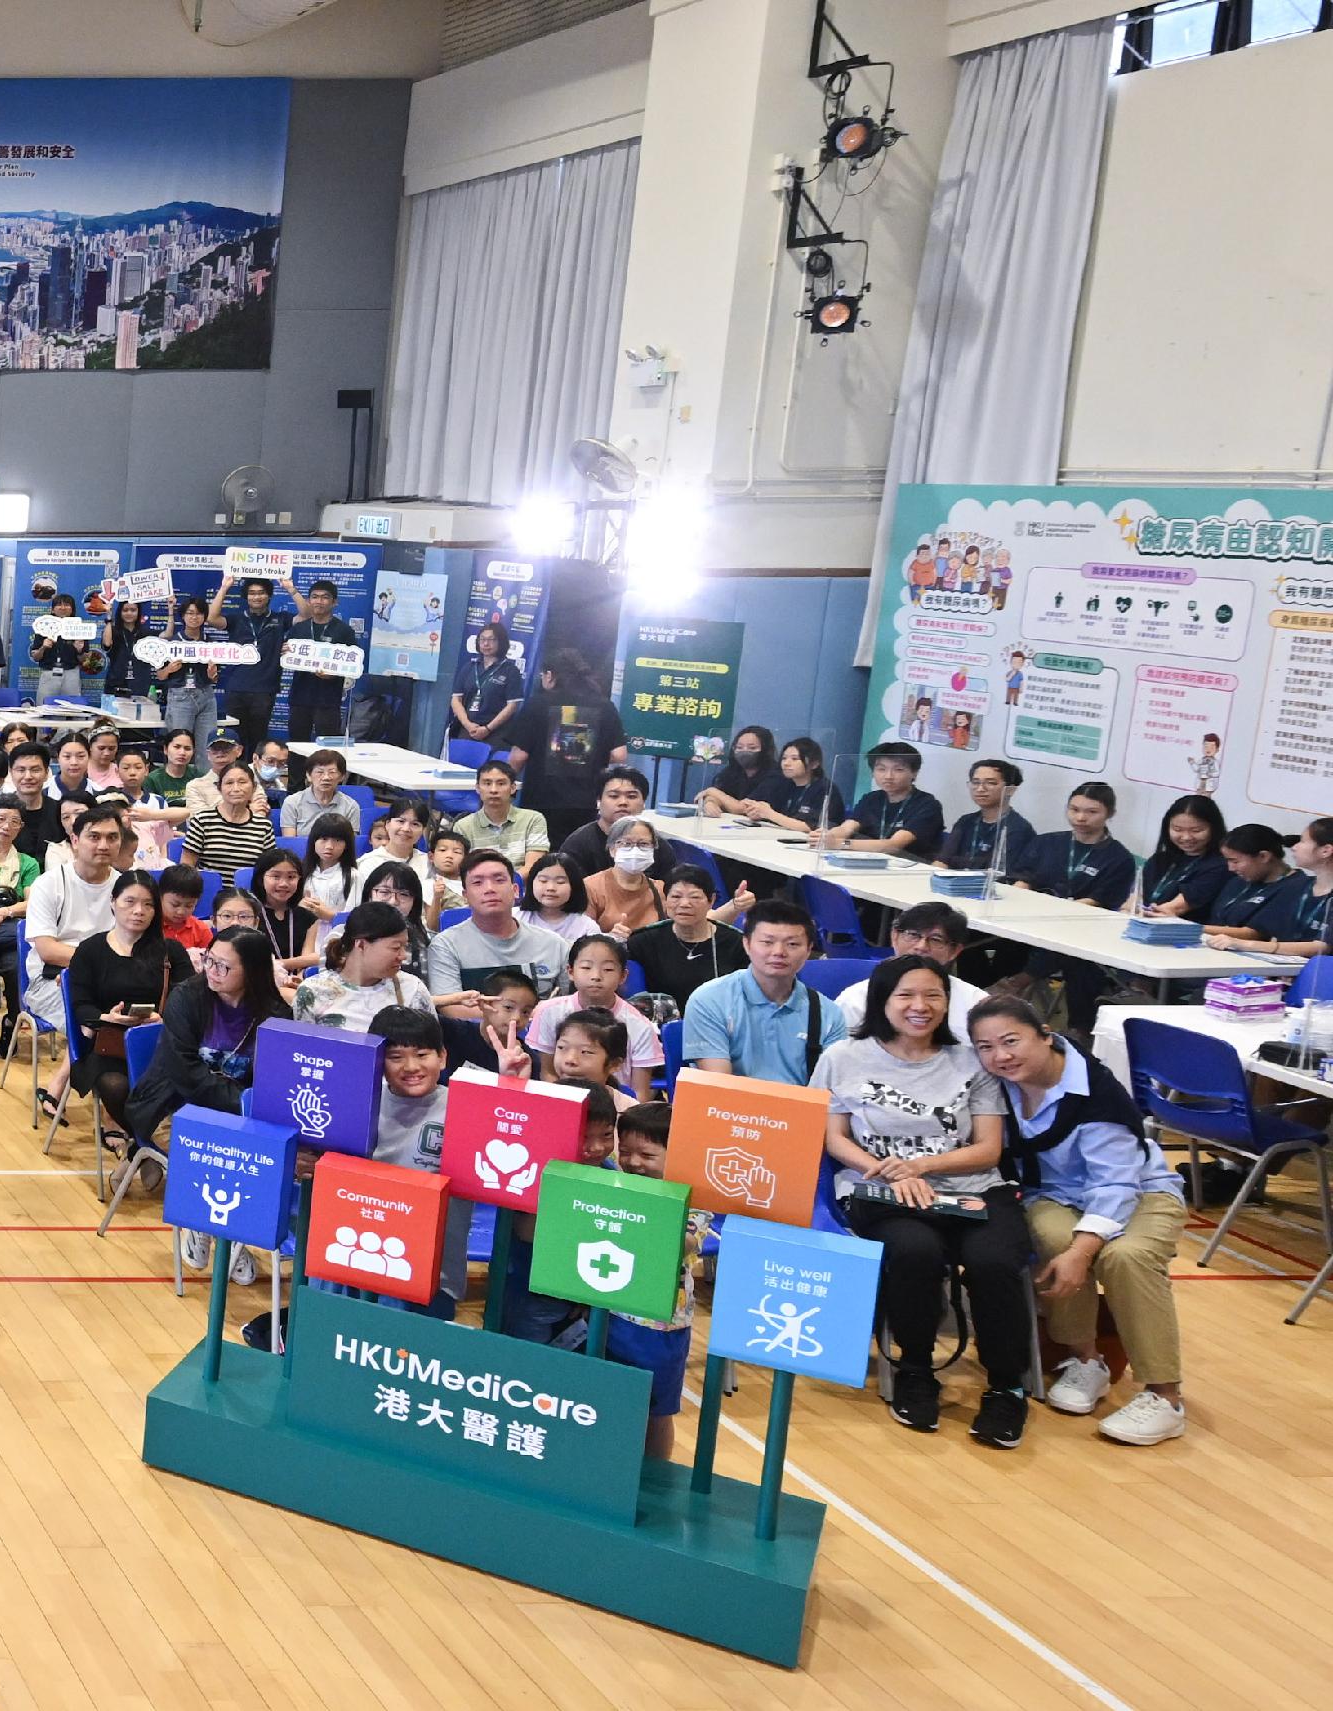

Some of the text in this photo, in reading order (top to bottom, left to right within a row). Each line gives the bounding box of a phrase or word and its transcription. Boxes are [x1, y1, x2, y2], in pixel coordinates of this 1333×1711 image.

[358, 517, 390, 535] EXIT 出口
[232, 552, 288, 564] INSPIRE
[242, 566, 263, 575] Young
[264, 567, 286, 575] Stroke
[170, 645, 240, 660] 中風年輕化
[633, 692, 722, 719] 專業諮詢
[293, 1052, 334, 1068] Shape
[494, 1107, 529, 1122] Care
[707, 1106, 788, 1131] Prevention
[496, 1121, 524, 1136] 關愛
[730, 1125, 761, 1142] 預防
[178, 1134, 275, 1166] Your Healthy Life
[189, 1151, 260, 1177] 你的健康人生
[336, 1187, 413, 1215] Community
[573, 1198, 646, 1225] Protection
[359, 1207, 386, 1222] 社區
[593, 1218, 623, 1235] 守護
[764, 1259, 832, 1284] Live well
[763, 1273, 829, 1299] 活出健康
[334, 1333, 598, 1427] HKUMediCare
[373, 1382, 548, 1462] 港大醫護
